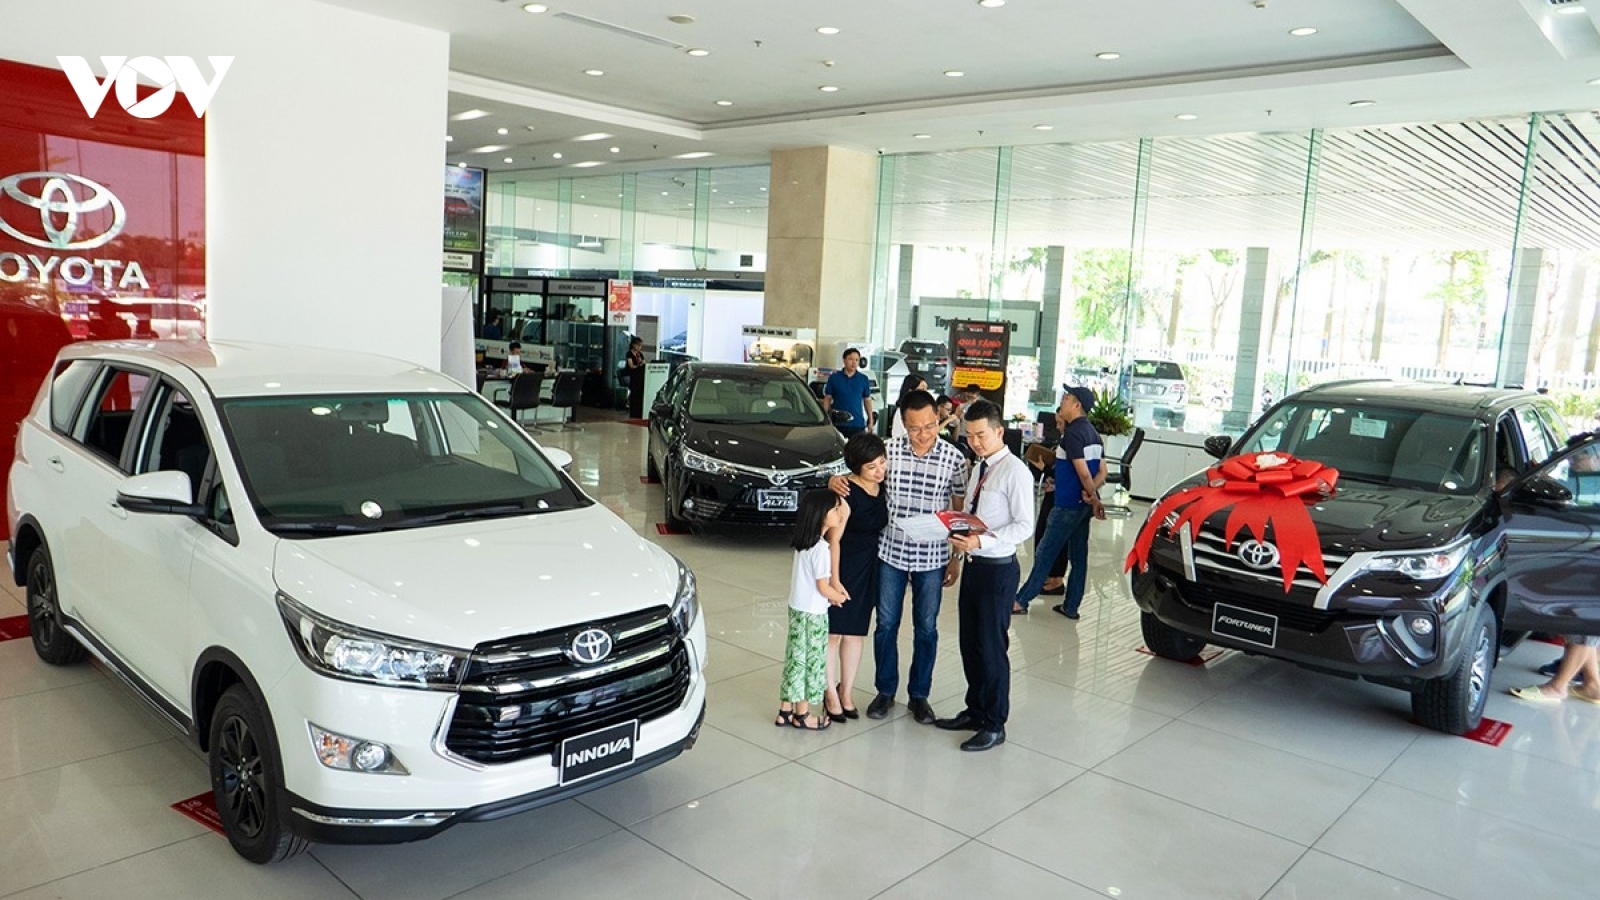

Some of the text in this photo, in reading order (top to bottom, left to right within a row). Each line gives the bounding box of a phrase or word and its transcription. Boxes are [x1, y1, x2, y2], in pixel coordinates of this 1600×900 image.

[0, 252, 150, 290] OYOTA
[1218, 615, 1272, 635] FORTUNER
[566, 737, 631, 768] INNOVA
